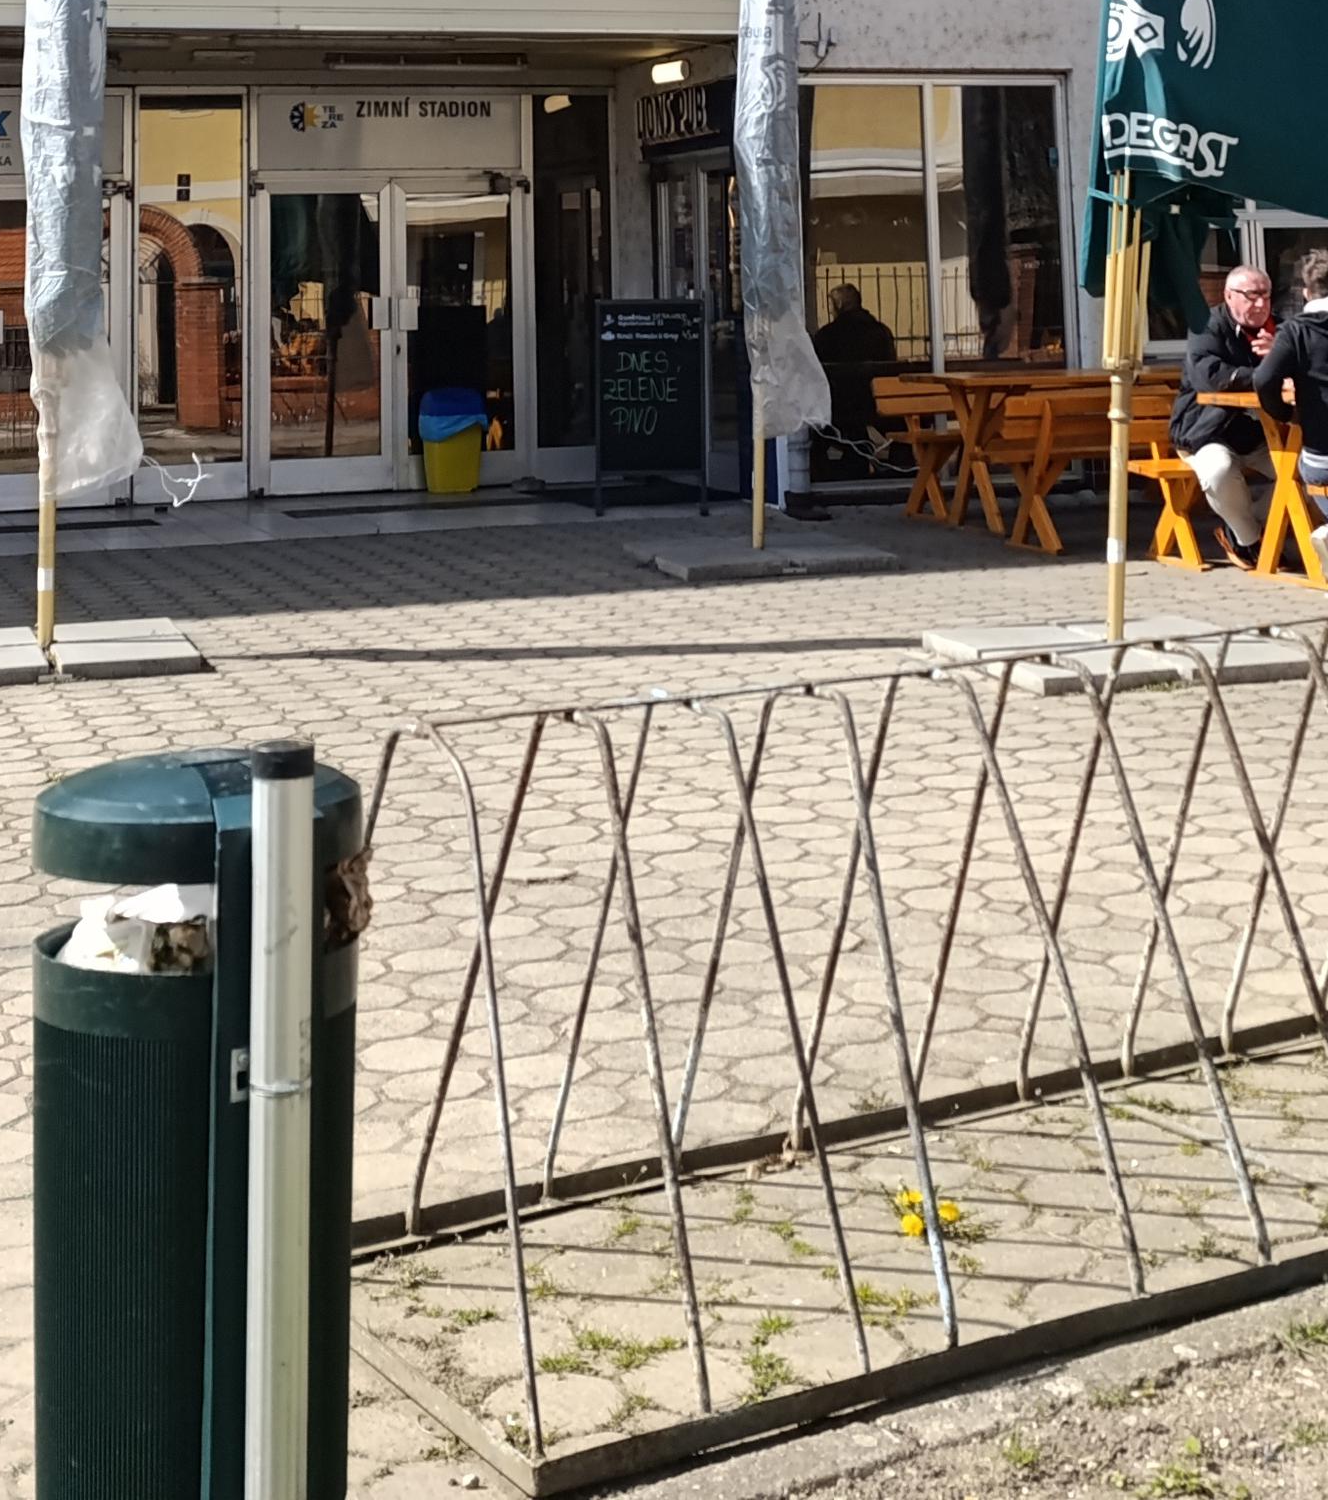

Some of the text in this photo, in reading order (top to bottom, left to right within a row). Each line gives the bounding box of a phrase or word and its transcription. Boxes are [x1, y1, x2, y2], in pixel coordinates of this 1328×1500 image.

[356, 97, 491, 118] ZIMNÍ STADION
[636, 85, 708, 140] LIONS PUB
